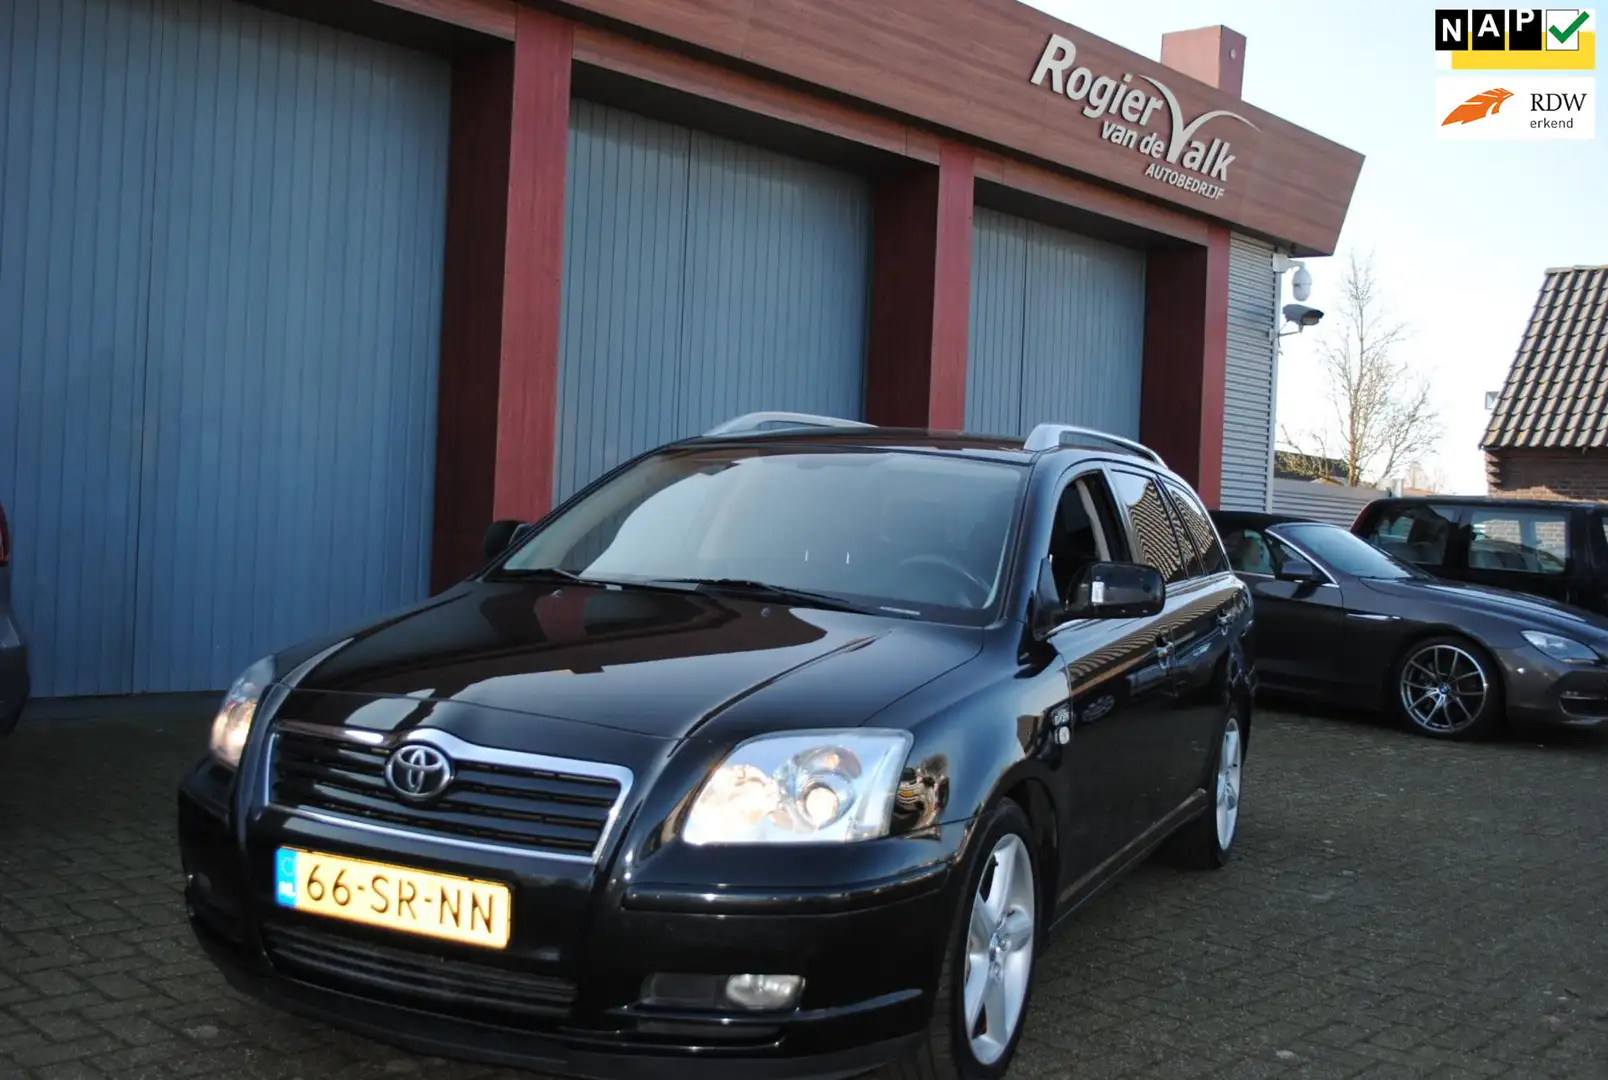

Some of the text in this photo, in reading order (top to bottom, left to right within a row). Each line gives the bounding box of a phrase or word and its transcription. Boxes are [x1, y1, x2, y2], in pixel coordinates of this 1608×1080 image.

[1030, 33, 1164, 126] Rogier
[1101, 75, 1262, 182] van de Valk
[1144, 163, 1226, 200] AUTOBEDRIJF
[307, 864, 494, 934] 66-SR-NN
